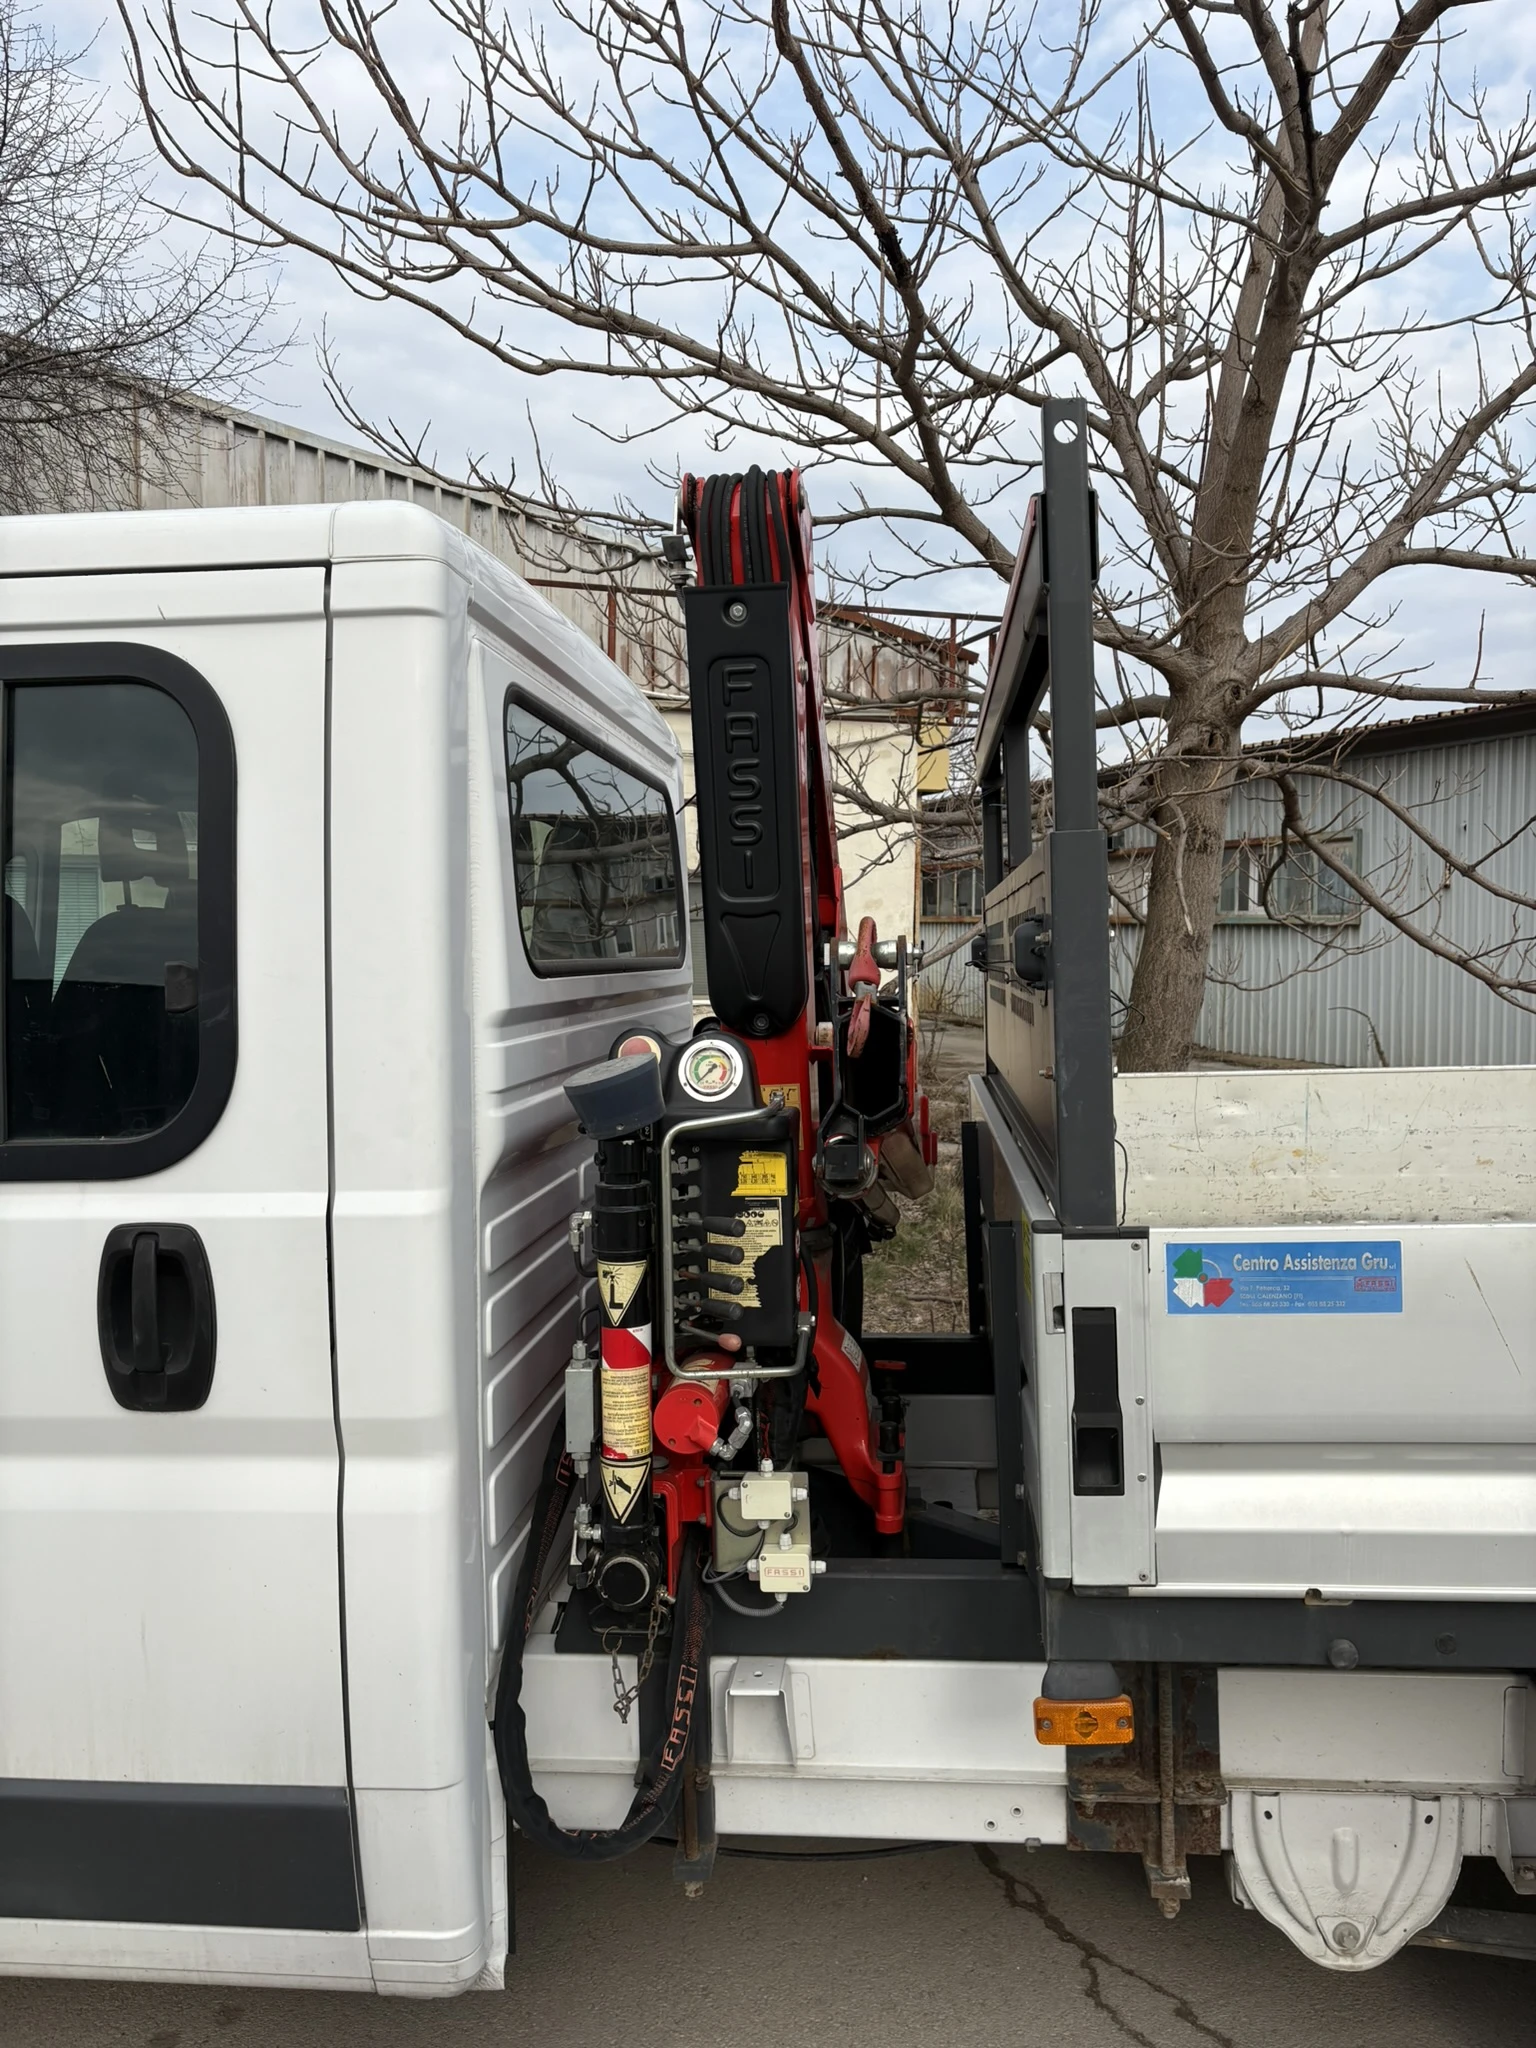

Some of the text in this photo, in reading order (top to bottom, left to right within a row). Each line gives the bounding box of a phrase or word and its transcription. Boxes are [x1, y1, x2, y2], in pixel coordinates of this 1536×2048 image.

[722, 663, 763, 890] FASSI
[1233, 1254, 1279, 1271] Centro
[1283, 1252, 1357, 1271] Assistenza
[1361, 1252, 1388, 1270] Gru
[767, 1568, 802, 1576] FASSI
[664, 1675, 696, 1763] FASSI
